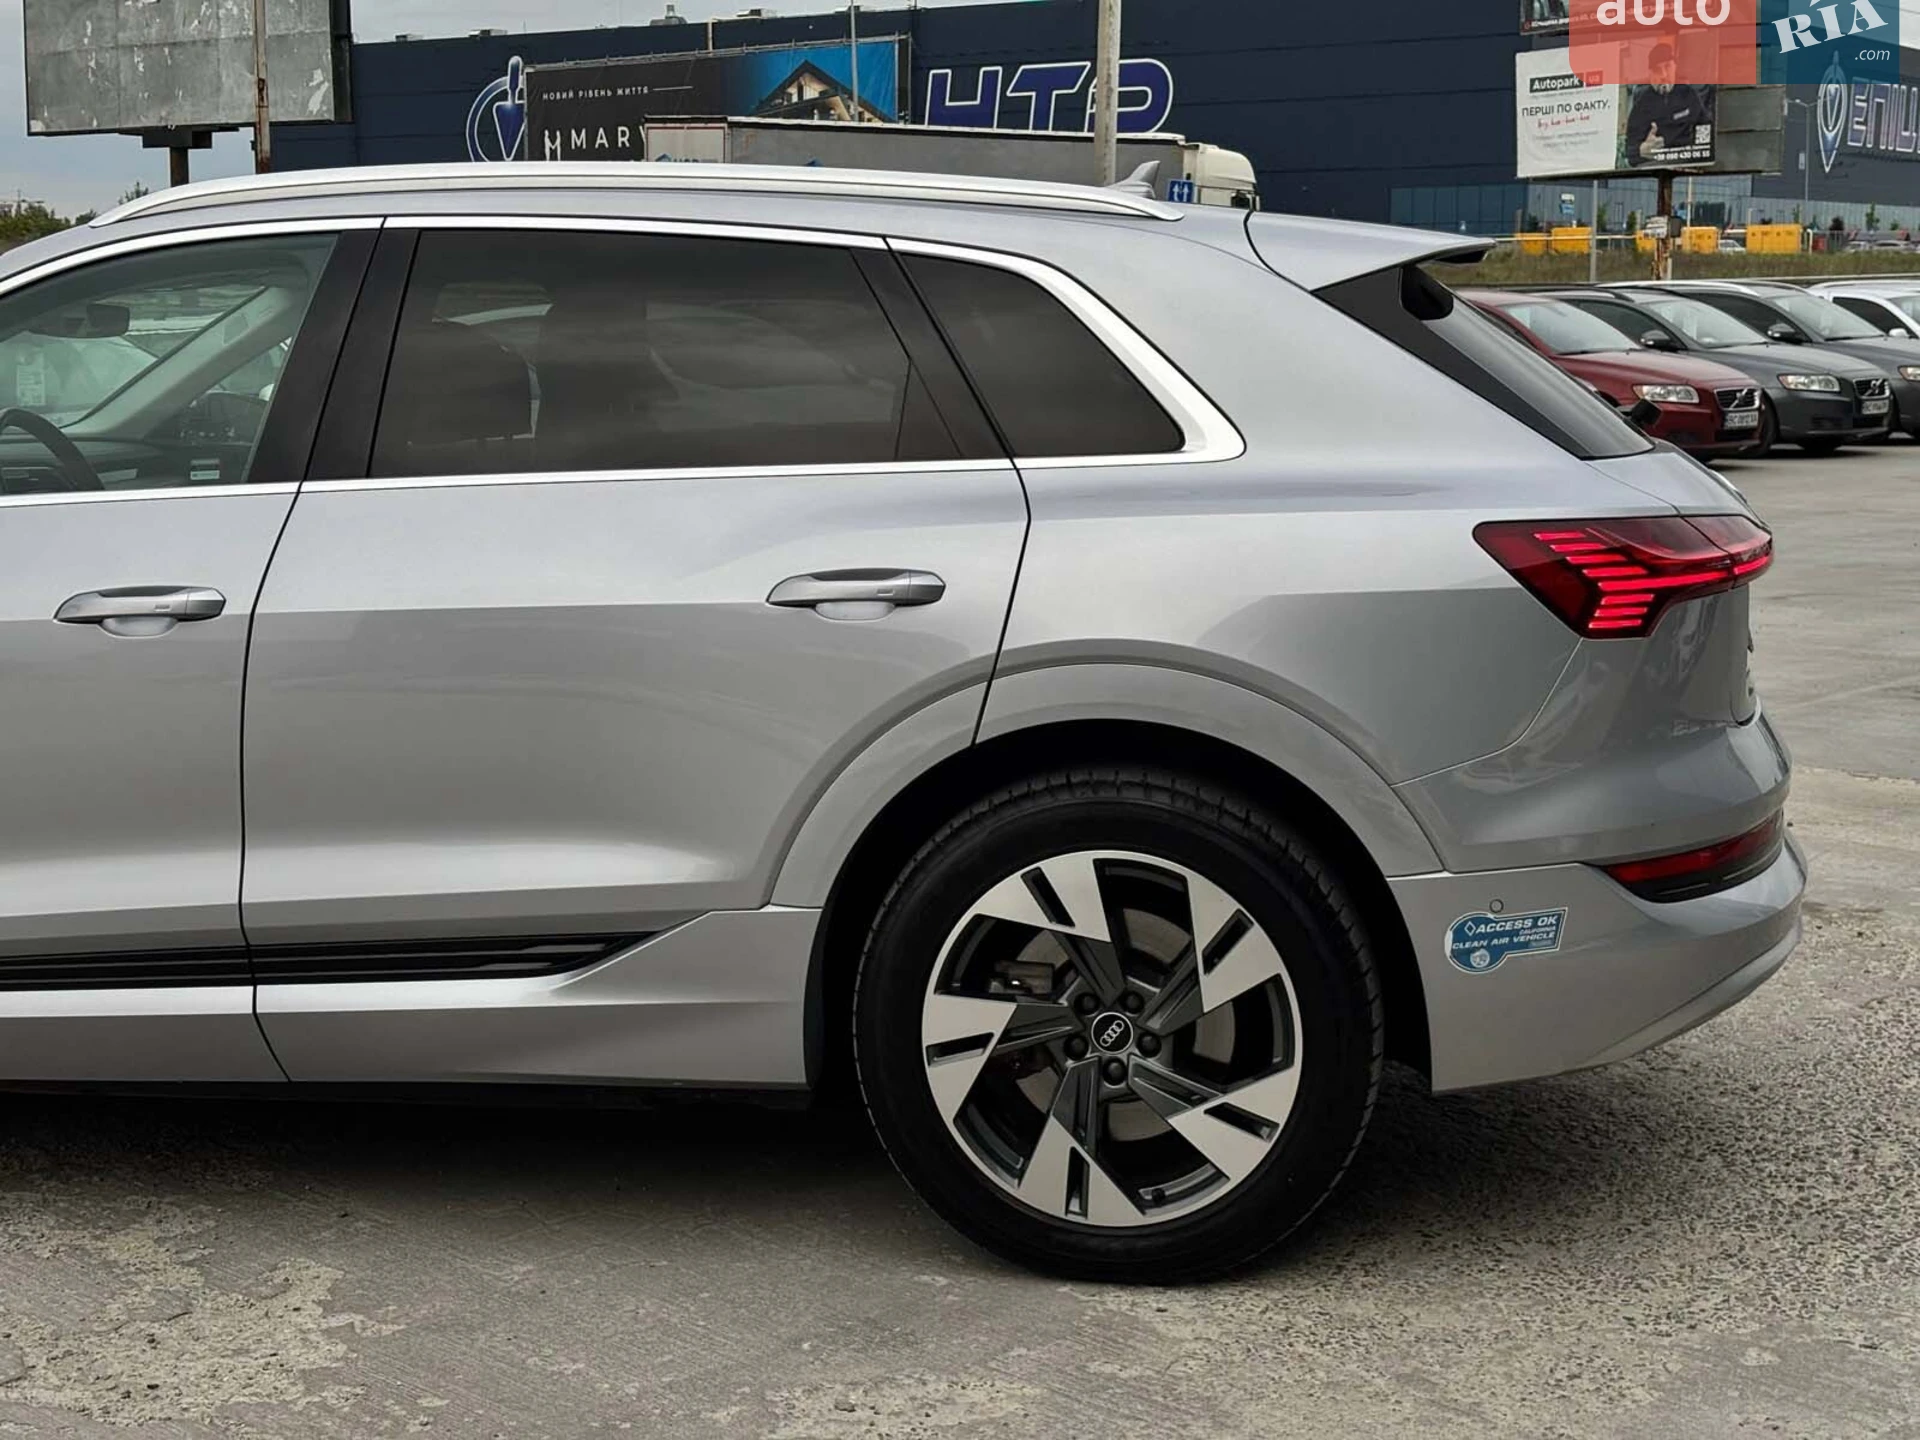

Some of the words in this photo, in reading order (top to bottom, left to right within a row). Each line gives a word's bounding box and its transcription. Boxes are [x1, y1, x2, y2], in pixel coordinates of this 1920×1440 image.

[1532, 75, 1580, 91] Autopark
[543, 89, 574, 100] НОВИЙ
[578, 87, 612, 99] РІВЕНЬ
[617, 85, 649, 96] ЖИТТЯ
[1522, 105, 1554, 117] ПЕРШІ
[1557, 103, 1572, 114] ПО
[1574, 99, 1610, 113] ФАКТУ.
[1847, 76, 1920, 153] ЕПІЦ
[1476, 918, 1533, 934] ACCESS
[1537, 915, 1558, 927] OK
[1519, 925, 1557, 936] CALIFORNIA
[1452, 940, 1488, 950] CLEAN
[1491, 937, 1509, 946] AIR
[1513, 931, 1556, 943] VEHICLE
